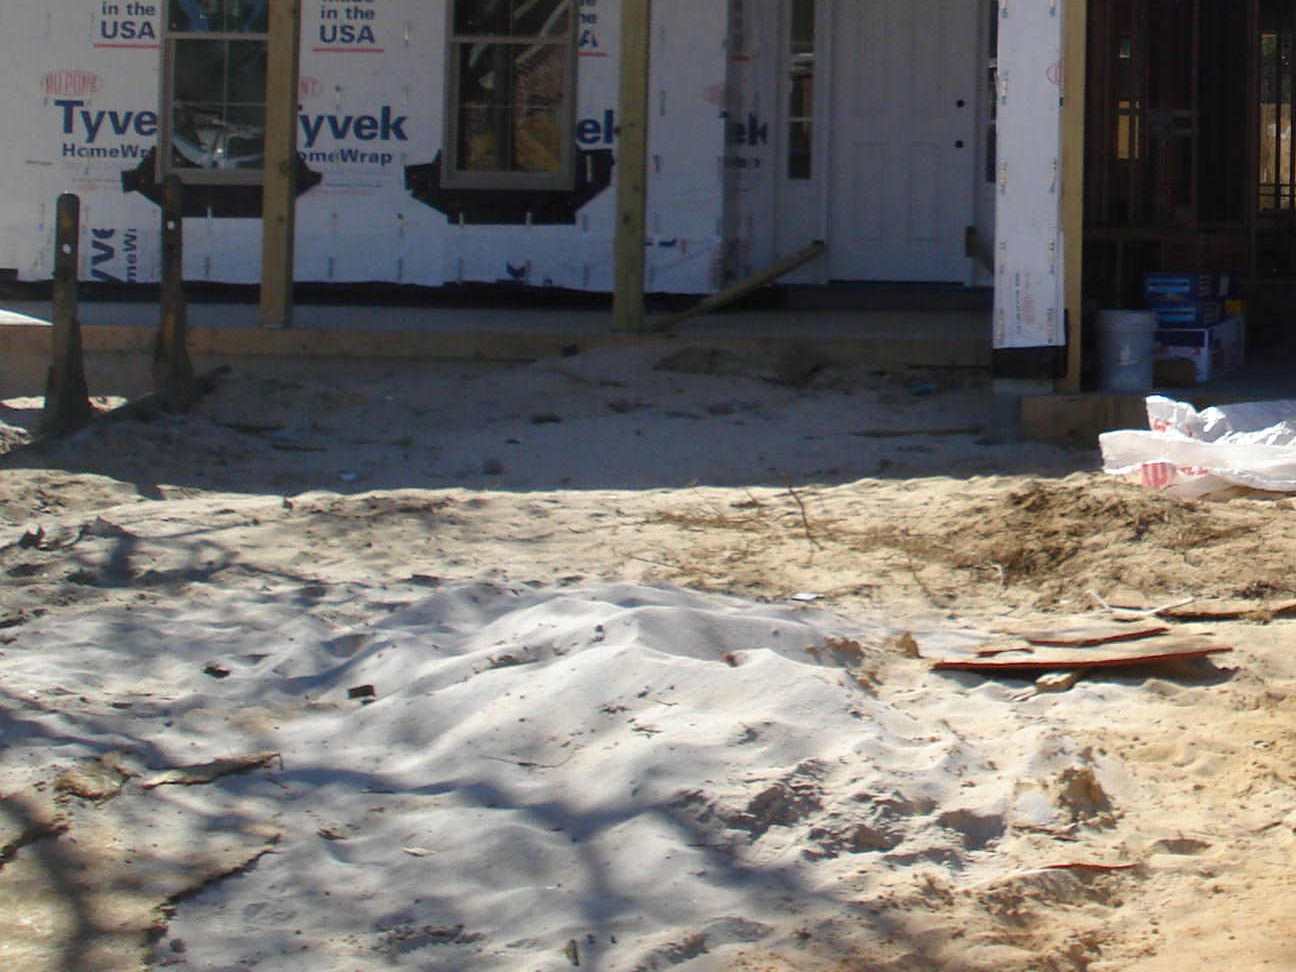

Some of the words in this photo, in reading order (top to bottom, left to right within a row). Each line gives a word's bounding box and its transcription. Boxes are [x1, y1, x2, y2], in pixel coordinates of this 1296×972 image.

[102, 2, 118, 15] in
[126, 2, 155, 16] the
[320, 6, 337, 19] in
[345, 6, 375, 20] the
[101, 21, 155, 39] USA
[319, 25, 375, 44] USA
